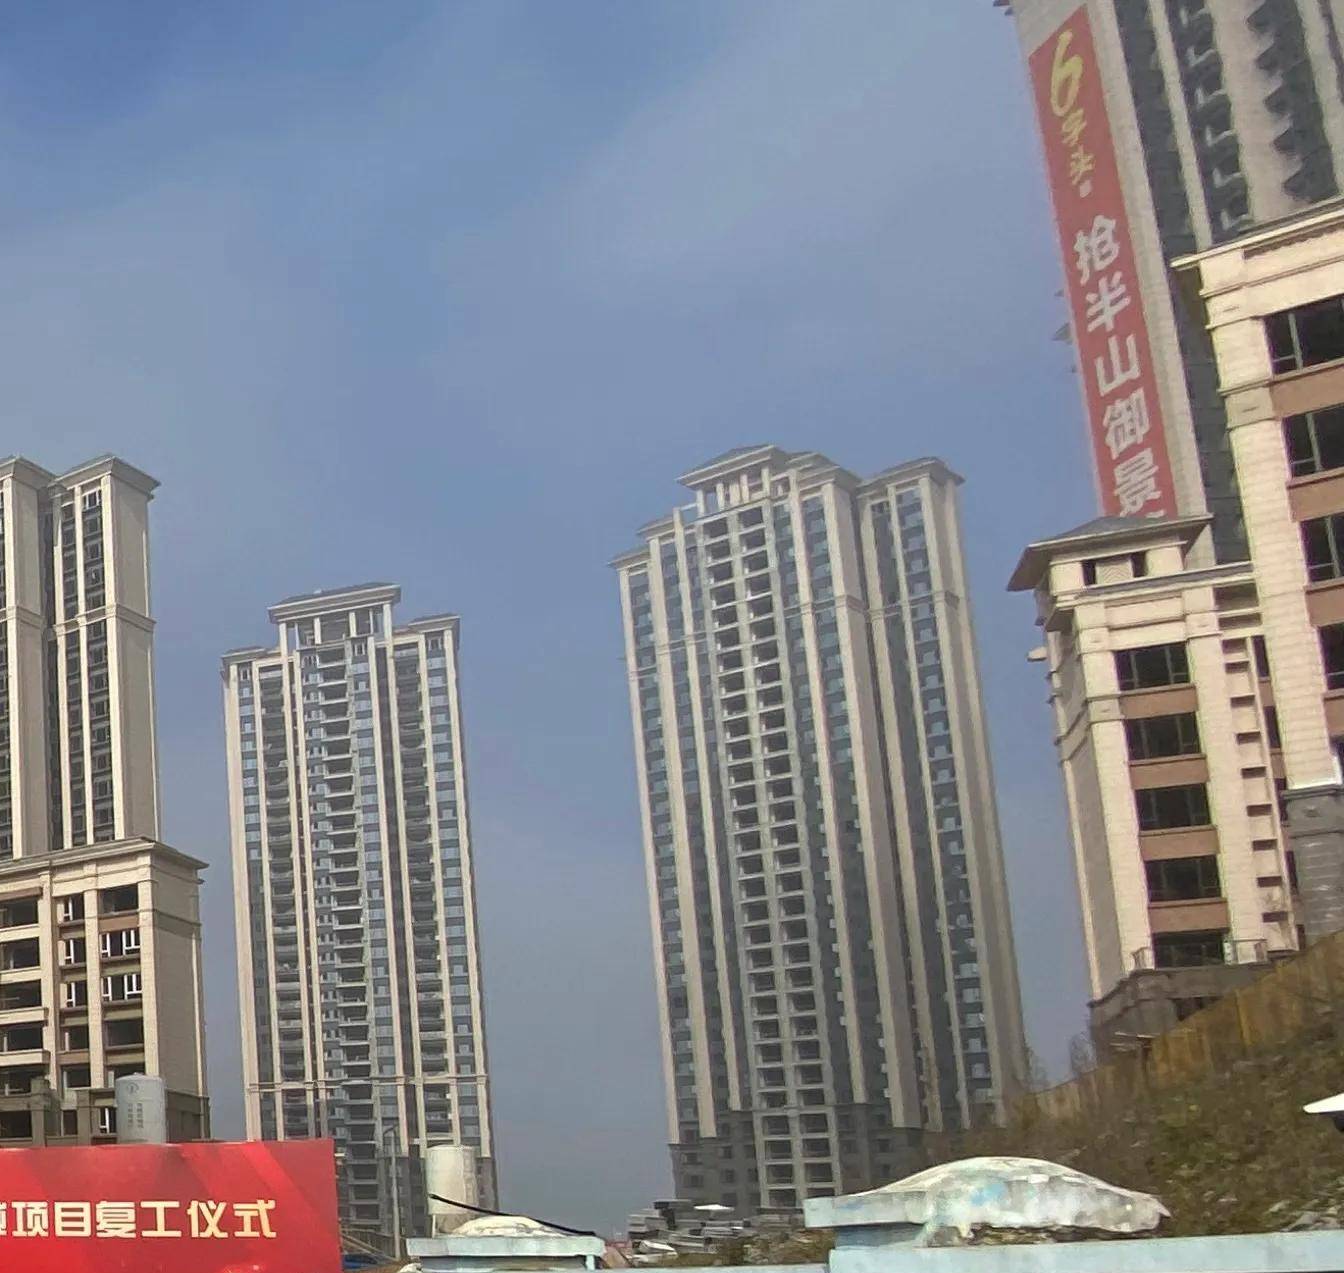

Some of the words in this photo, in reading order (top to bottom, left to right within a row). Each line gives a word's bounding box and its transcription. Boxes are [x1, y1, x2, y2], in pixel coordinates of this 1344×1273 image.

[1074, 214, 1165, 519] 抢半山御景
